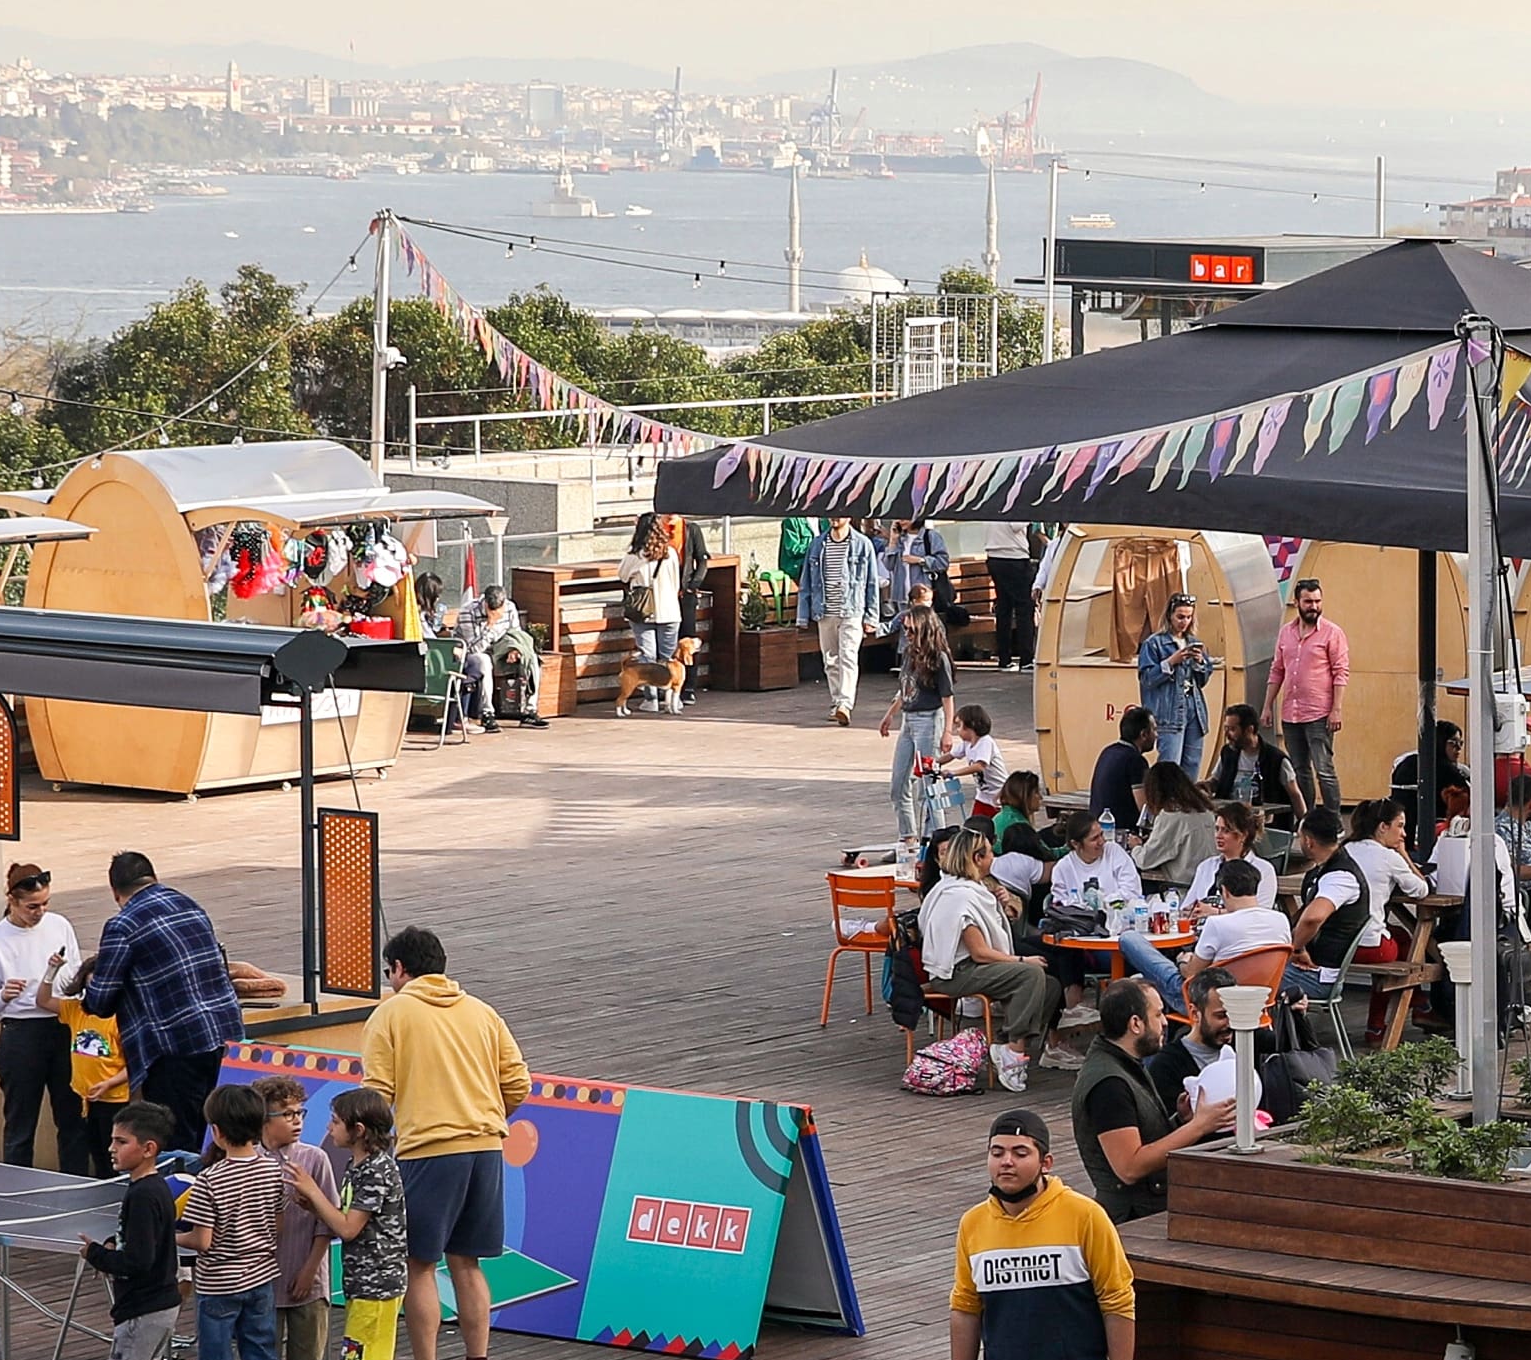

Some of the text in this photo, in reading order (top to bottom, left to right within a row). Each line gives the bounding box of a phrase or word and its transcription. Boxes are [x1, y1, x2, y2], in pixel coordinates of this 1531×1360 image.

[1194, 259, 1244, 278] bar
[637, 1208, 740, 1243] dekk
[984, 1253, 1062, 1285] DISTRICT
